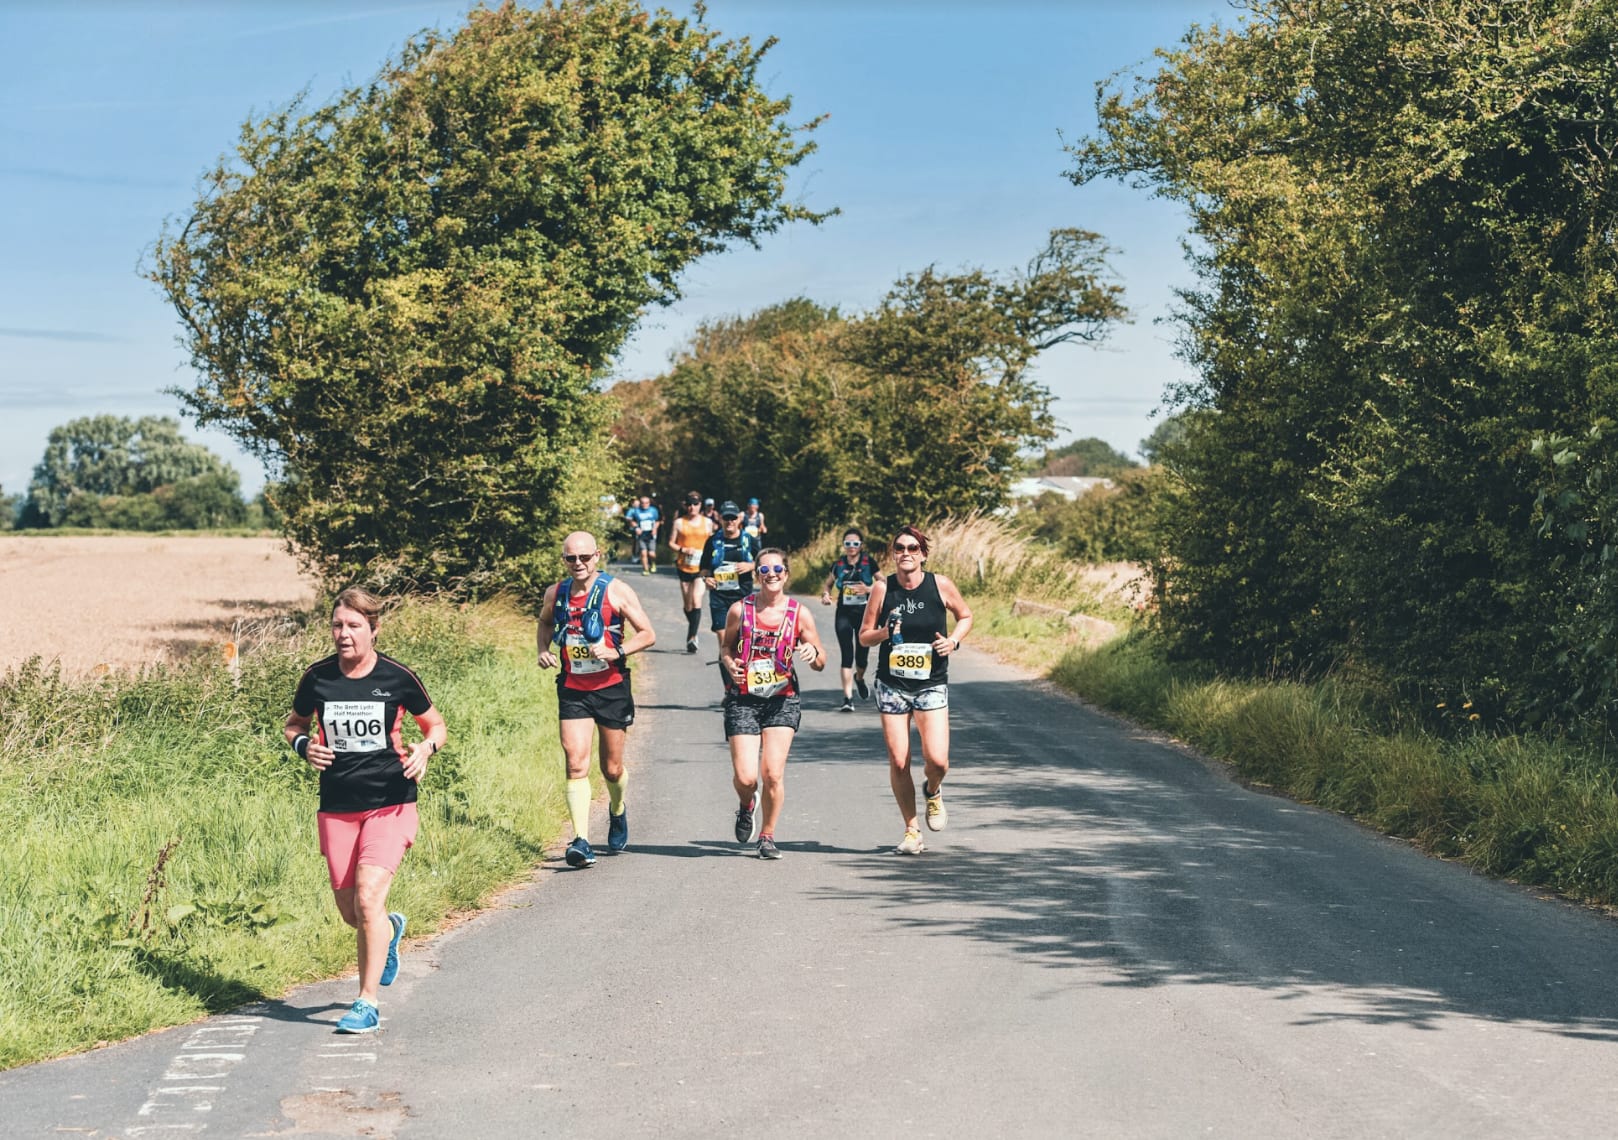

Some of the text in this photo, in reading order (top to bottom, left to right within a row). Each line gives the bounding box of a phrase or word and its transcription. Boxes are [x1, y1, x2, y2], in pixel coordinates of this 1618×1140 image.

[572, 646, 591, 659] 39
[896, 655, 925, 669] 389
[328, 719, 382, 737] 1106
